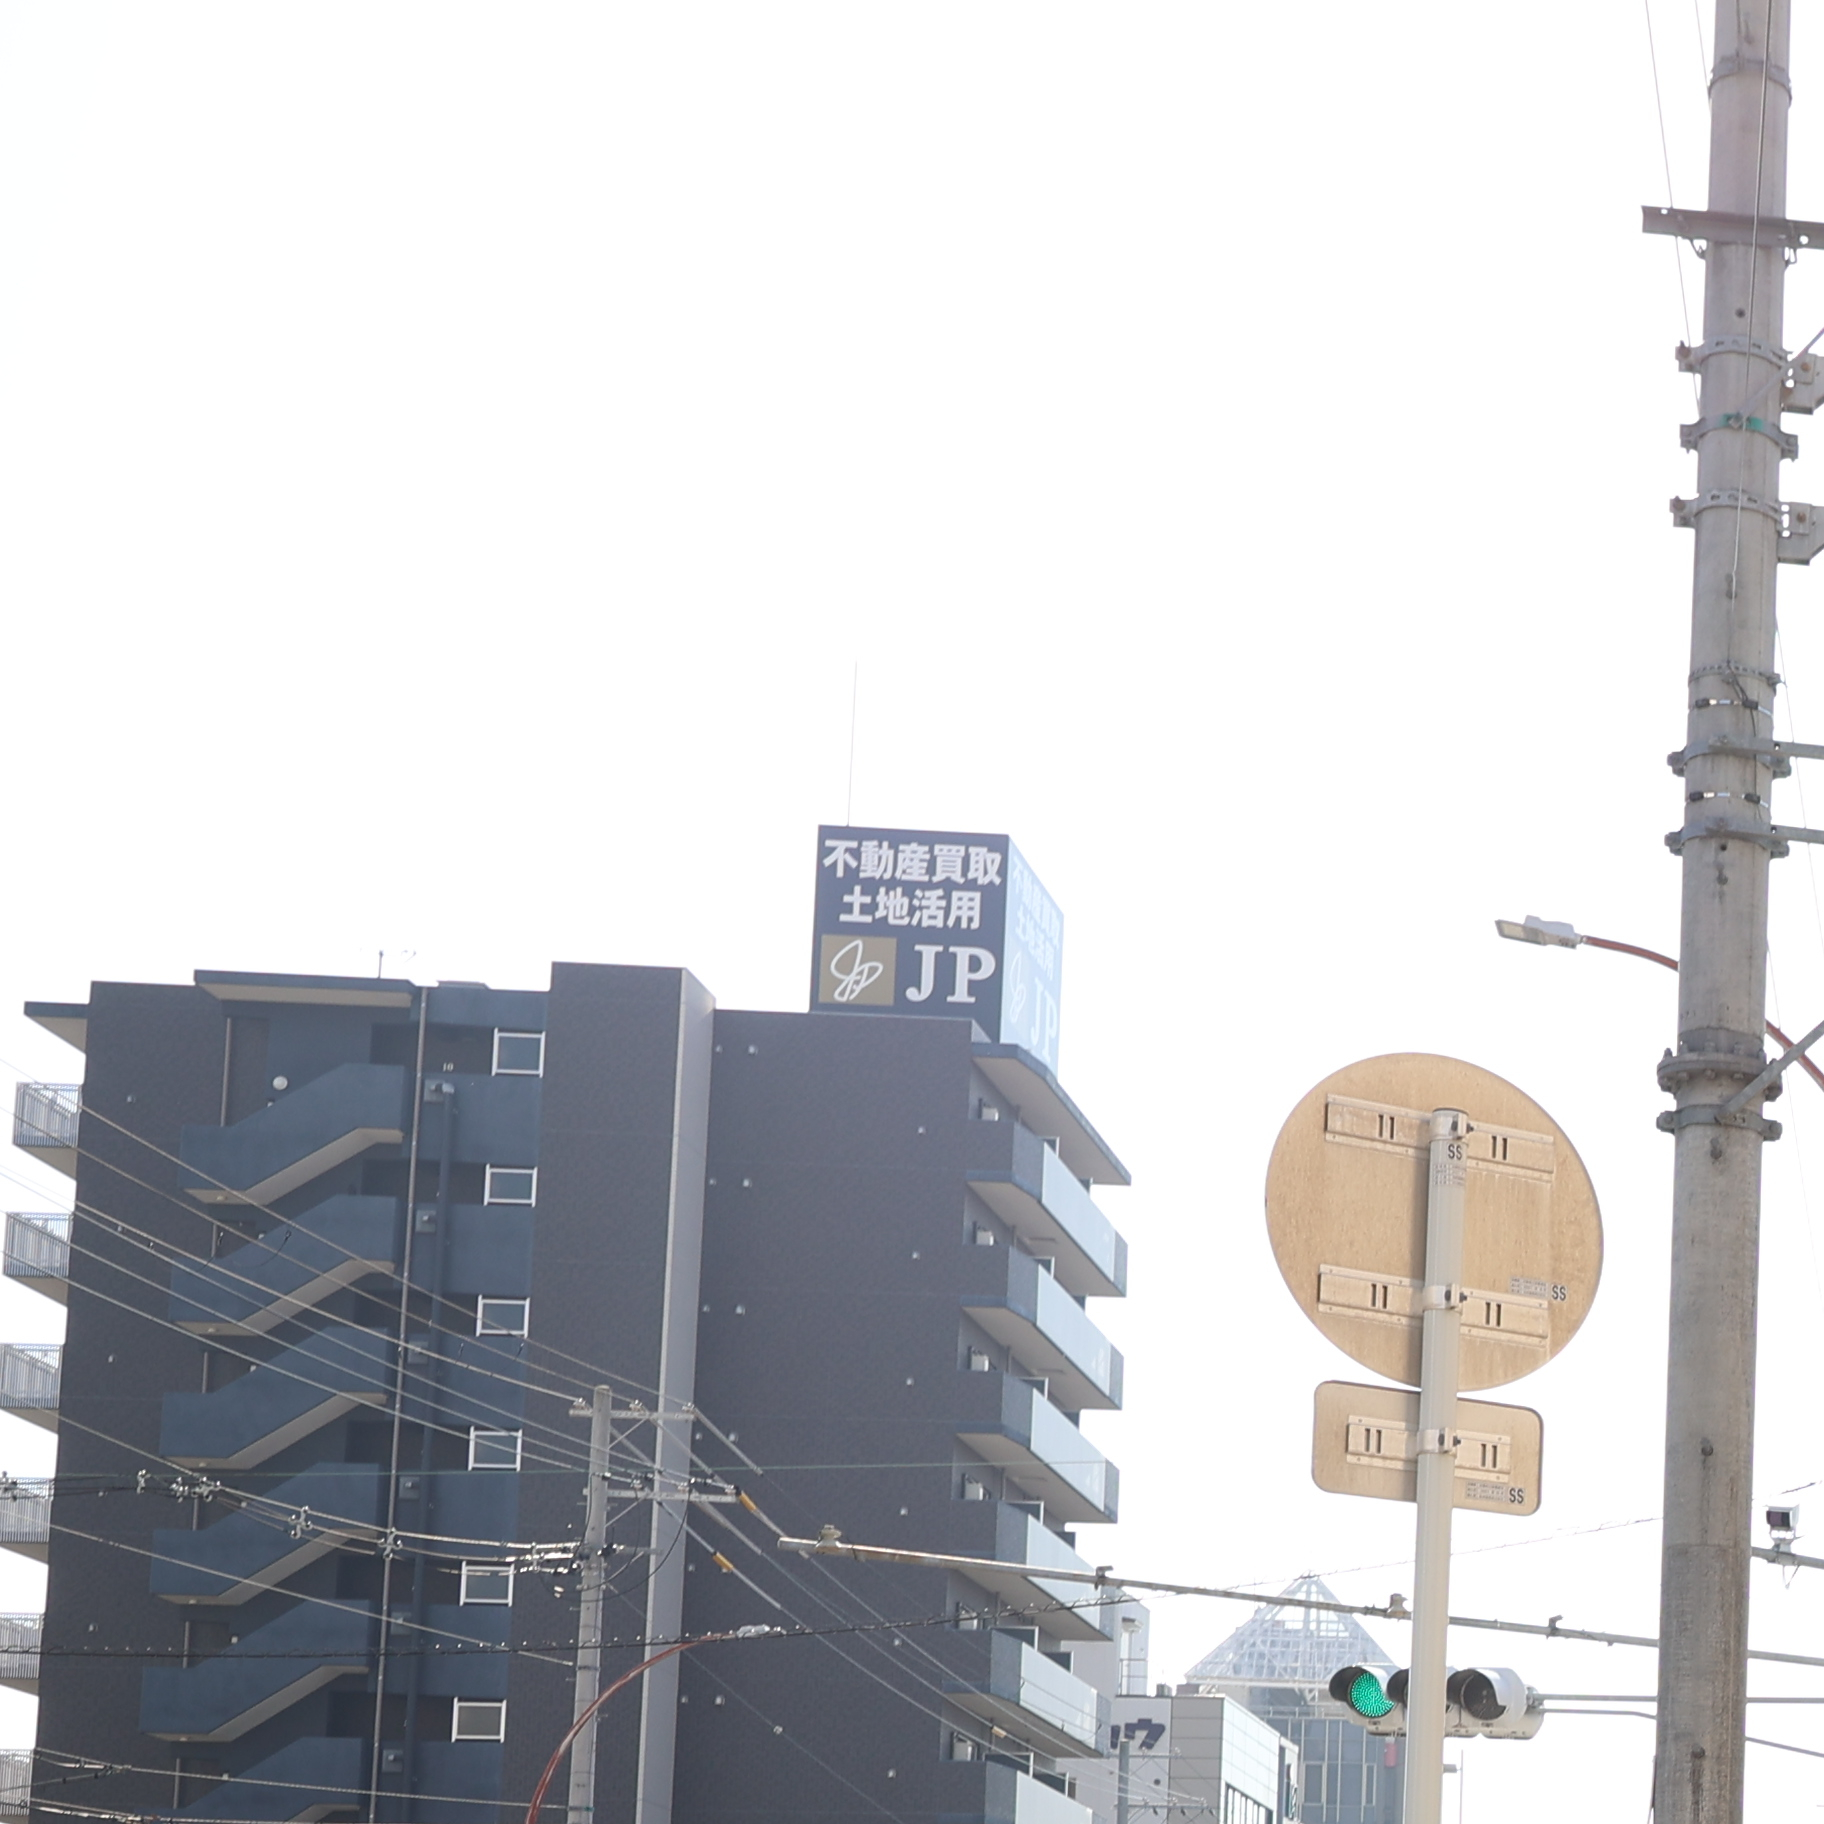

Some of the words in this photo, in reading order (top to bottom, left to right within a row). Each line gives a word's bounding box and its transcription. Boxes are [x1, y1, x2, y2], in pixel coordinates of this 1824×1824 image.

[822, 839, 1002, 886] 不動産買取
[839, 885, 982, 931] 土地活用
[905, 944, 996, 1004] JP
[1447, 1143, 1463, 1161] SS
[1551, 1284, 1567, 1302] SS
[1508, 1487, 1525, 1504] SS
